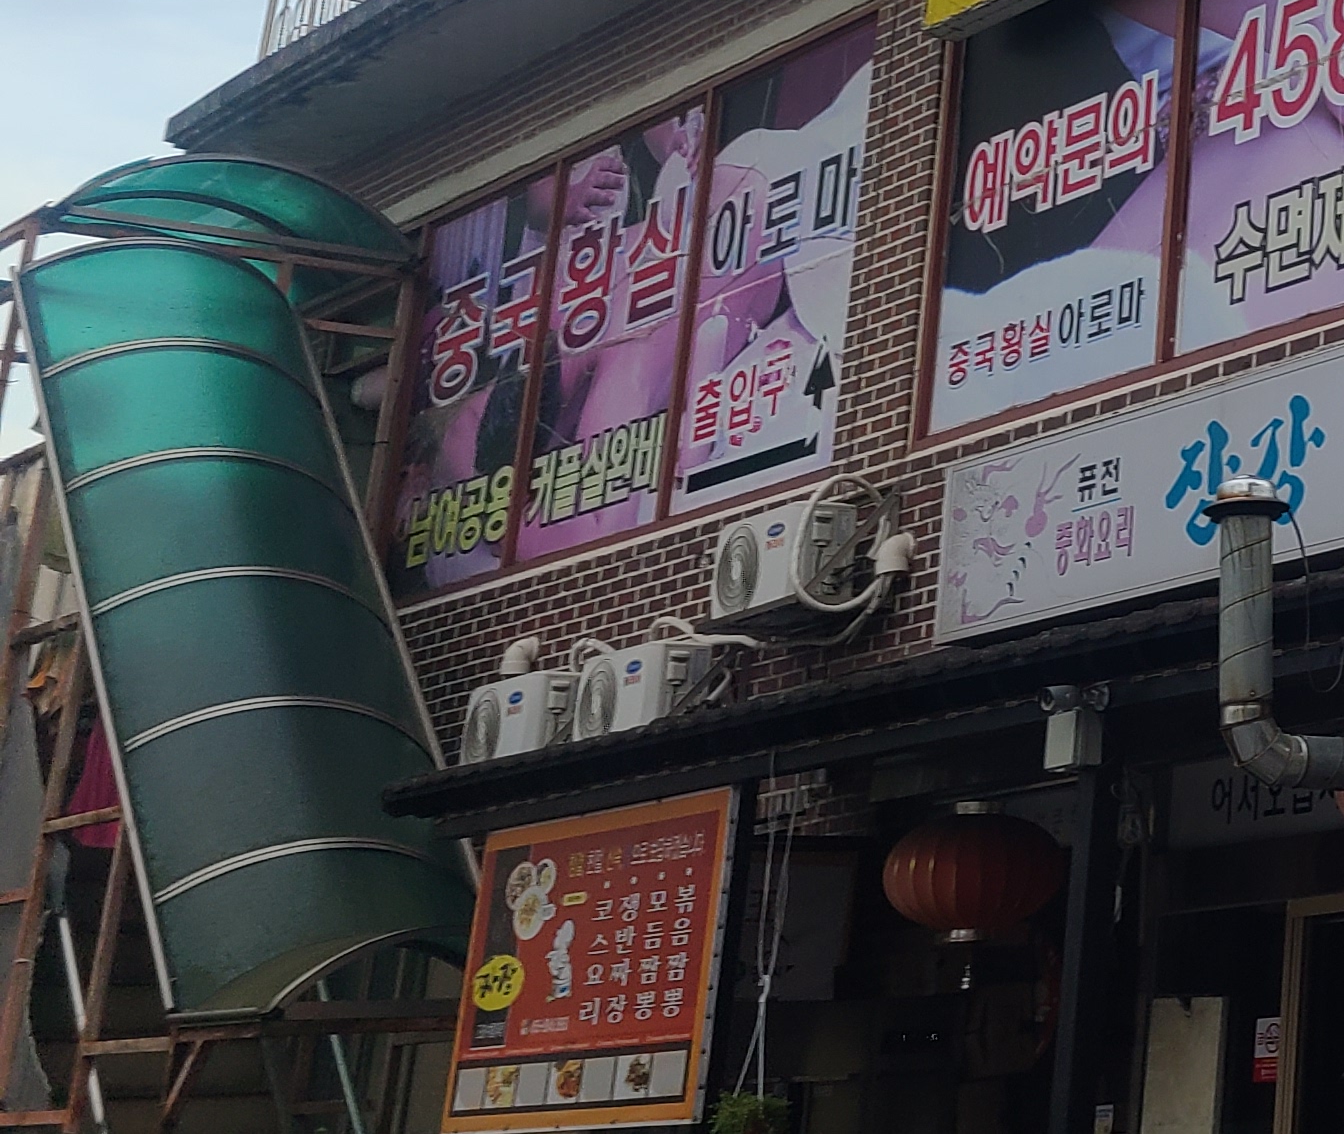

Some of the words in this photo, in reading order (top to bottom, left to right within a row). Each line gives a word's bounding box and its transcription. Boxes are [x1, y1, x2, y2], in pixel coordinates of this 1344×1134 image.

[965, 70, 1159, 232] 예약문의
[431, 179, 692, 407] 중국황실
[712, 144, 861, 277] 아로마
[947, 310, 1053, 389] 중국황실
[1057, 278, 1146, 347] 아로마
[528, 411, 666, 528] 커플실완비
[1077, 457, 1121, 502] 퓨전
[1054, 505, 1135, 577] 중화요리
[578, 899, 613, 1025] 코스요리
[604, 892, 641, 1024] 쟁반짜장
